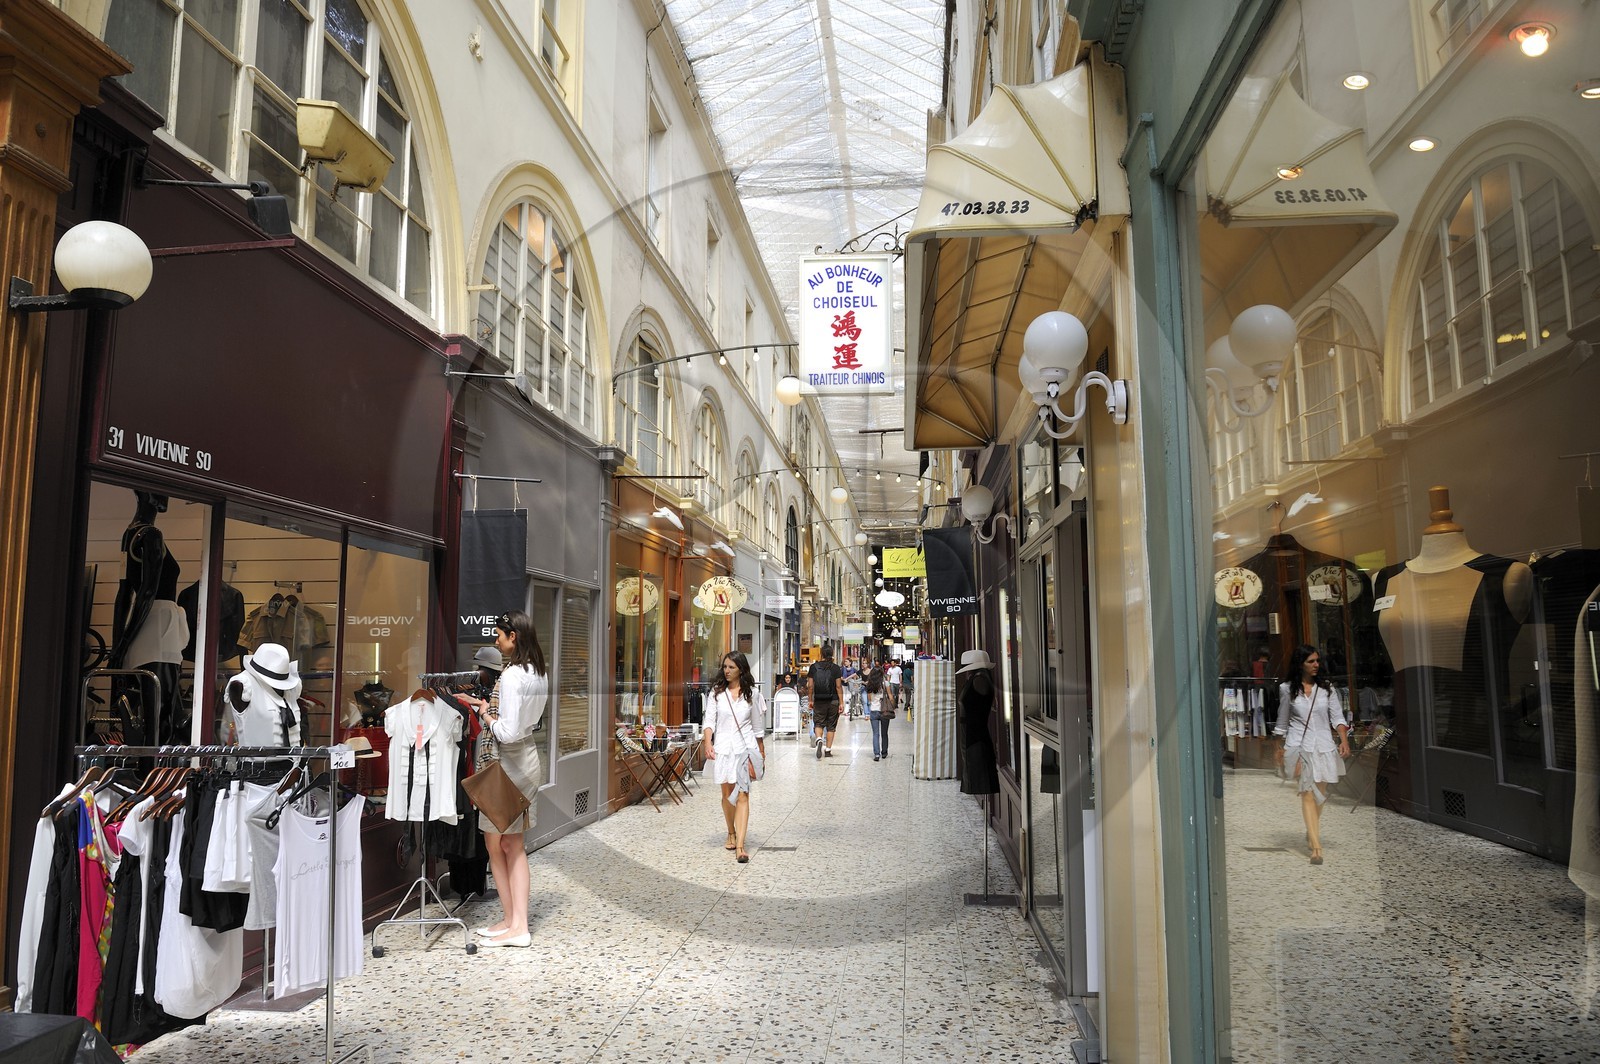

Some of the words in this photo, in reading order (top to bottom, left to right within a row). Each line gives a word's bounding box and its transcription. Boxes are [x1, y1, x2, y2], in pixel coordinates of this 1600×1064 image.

[941, 200, 1030, 216] 47.03.38.33
[807, 272, 824, 290] AU
[825, 264, 883, 288] BONHEUR
[836, 281, 854, 293] DE
[813, 295, 877, 309] CHOISEUL
[808, 372, 850, 386] TRAITEUR
[852, 371, 885, 385] CHINOIS
[108, 426, 124, 450] 31
[136, 433, 190, 466] VIVIENNE
[196, 450, 211, 471] SO
[930, 596, 976, 606] VIVIENNE
[946, 605, 961, 613] SO
